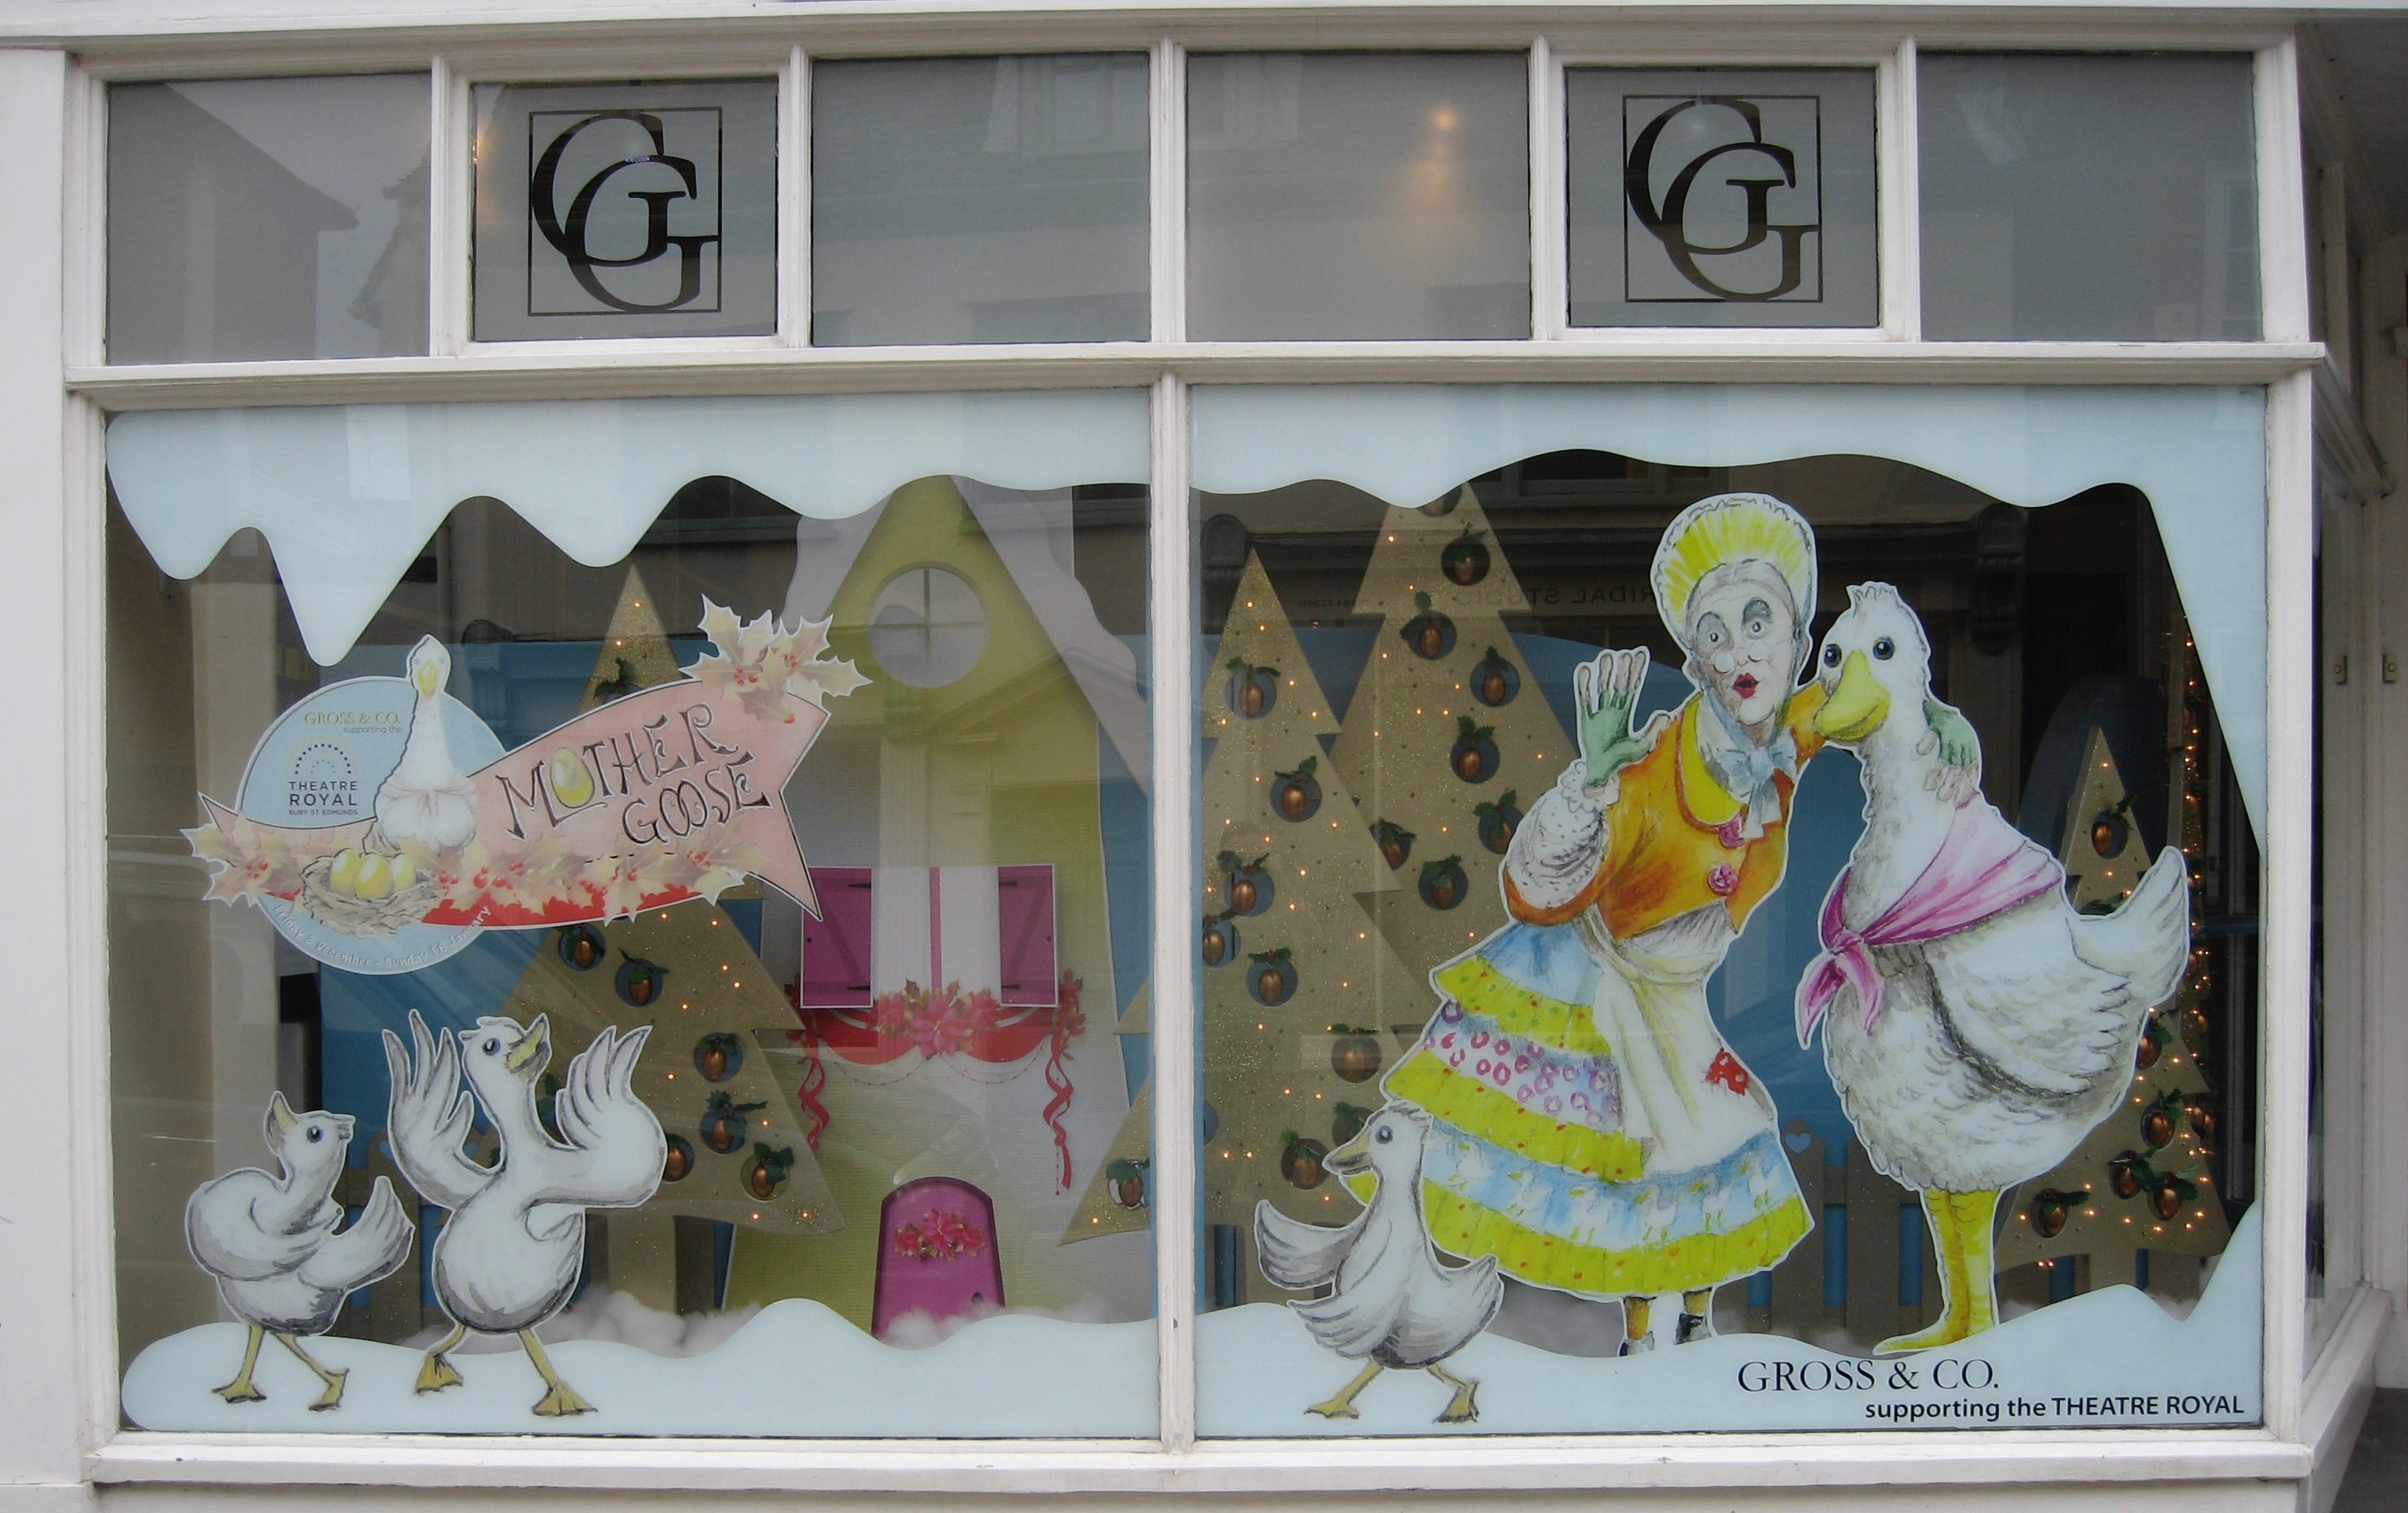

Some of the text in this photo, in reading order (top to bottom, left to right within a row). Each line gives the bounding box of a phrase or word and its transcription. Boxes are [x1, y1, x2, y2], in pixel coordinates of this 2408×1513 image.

[304, 711, 401, 725] GROSS & CO.
[289, 781, 358, 791] THEATRE
[495, 703, 739, 841] MOTHER
[289, 793, 358, 806] ROYAL
[621, 751, 772, 845] GOOSE
[275, 904, 305, 939] Friday
[316, 942, 372, 967] December
[385, 951, 429, 967] Sunday
[449, 906, 492, 944] January
[1737, 1358, 1999, 1392] GROSS & CO.
[1865, 1395, 2244, 1423] supporting the THEATRE ROYAL
